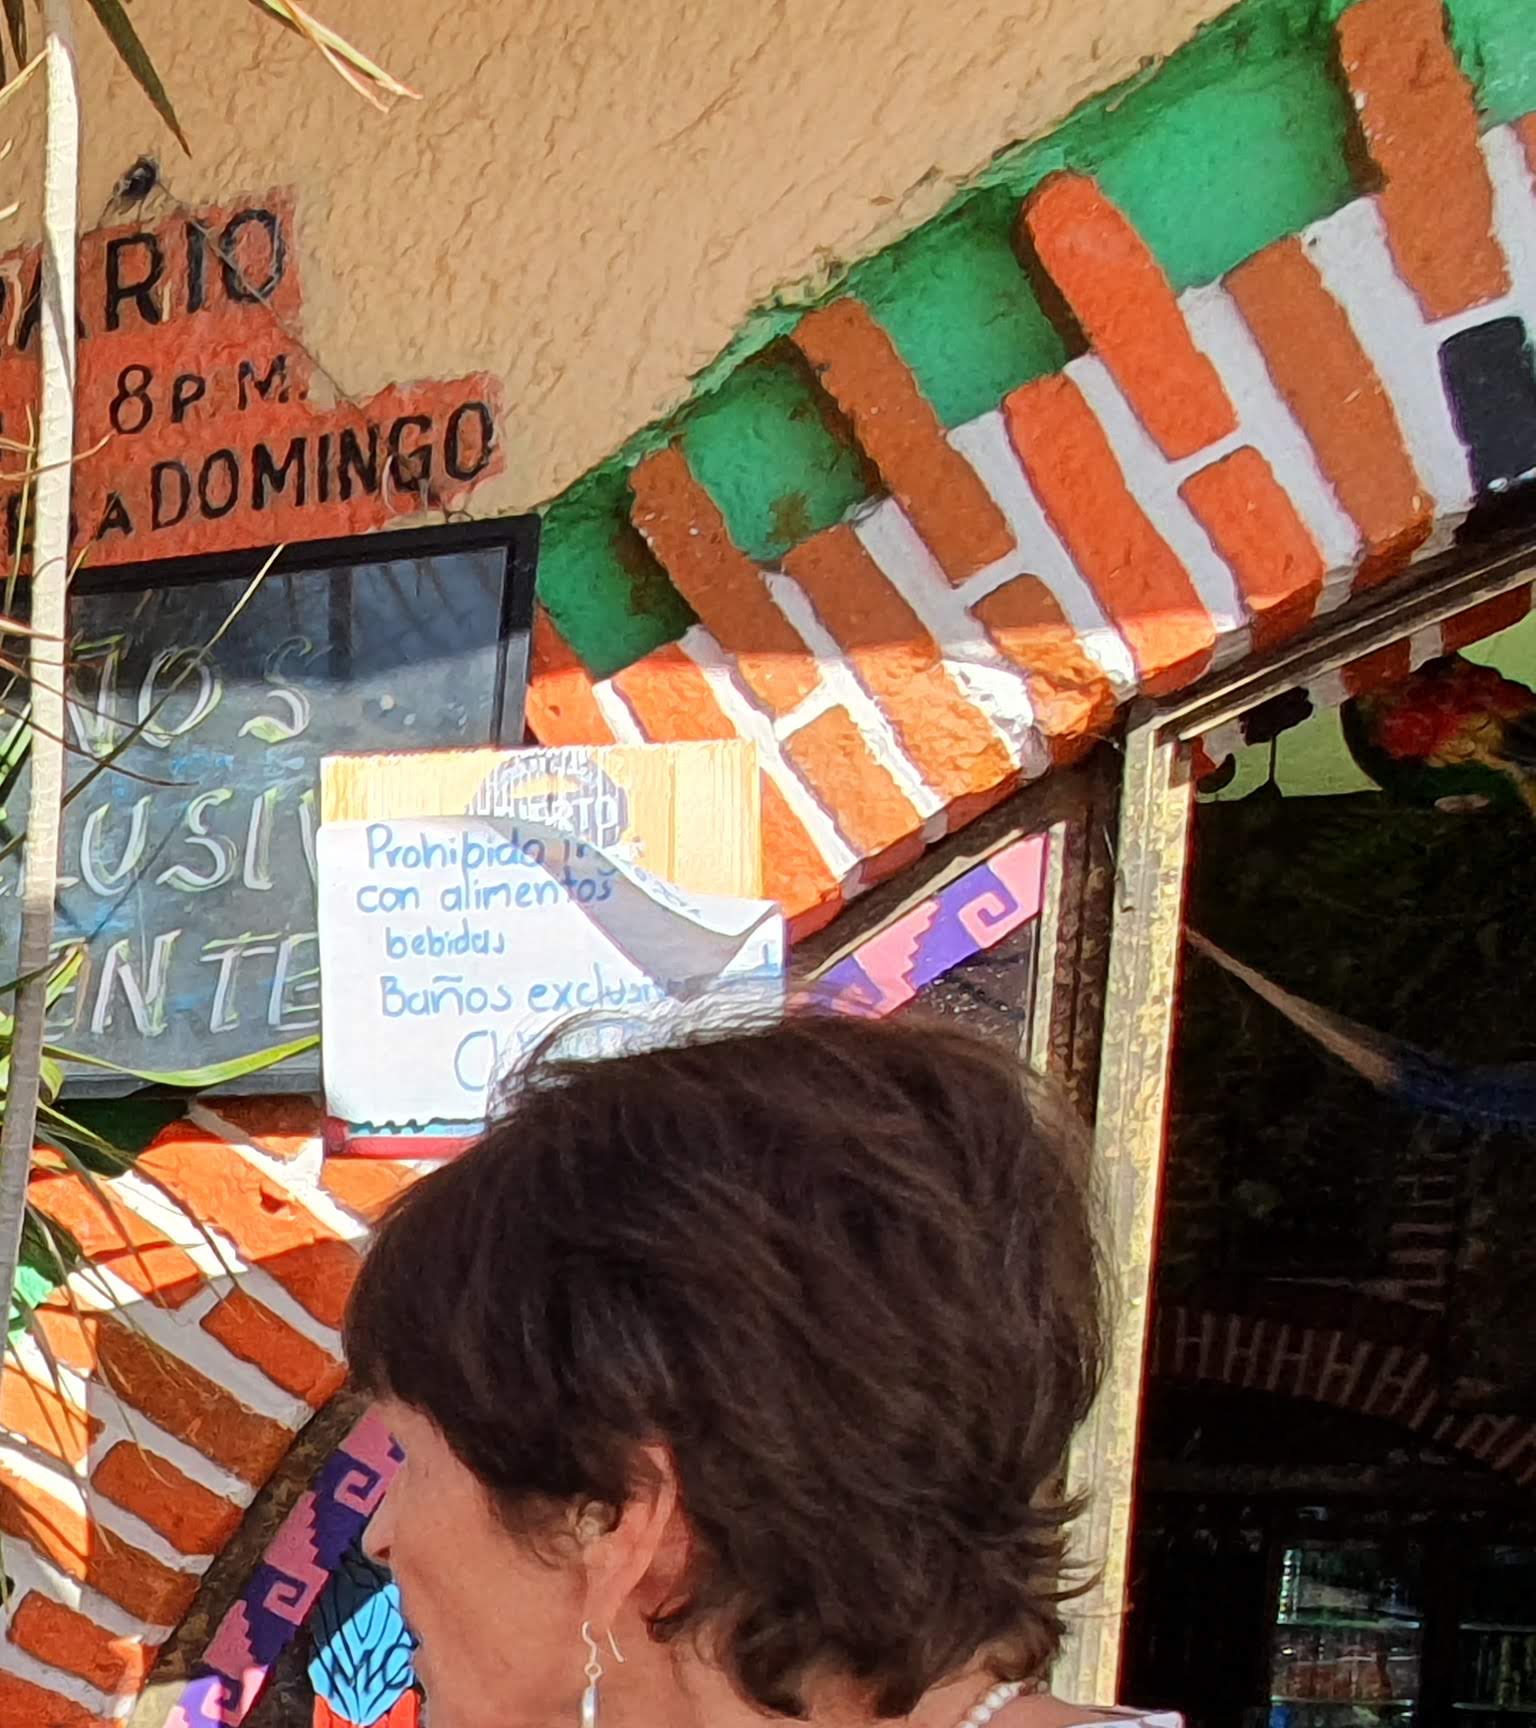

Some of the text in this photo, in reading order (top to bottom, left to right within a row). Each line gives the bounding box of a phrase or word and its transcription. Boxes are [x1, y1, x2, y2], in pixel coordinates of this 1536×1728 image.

[109, 363, 154, 435] 8
[150, 401, 494, 532] DOMINGO
[365, 822, 546, 872] Prohibido
[355, 883, 421, 913] con
[440, 866, 614, 913] alimentos
[379, 974, 513, 1018] Baños
